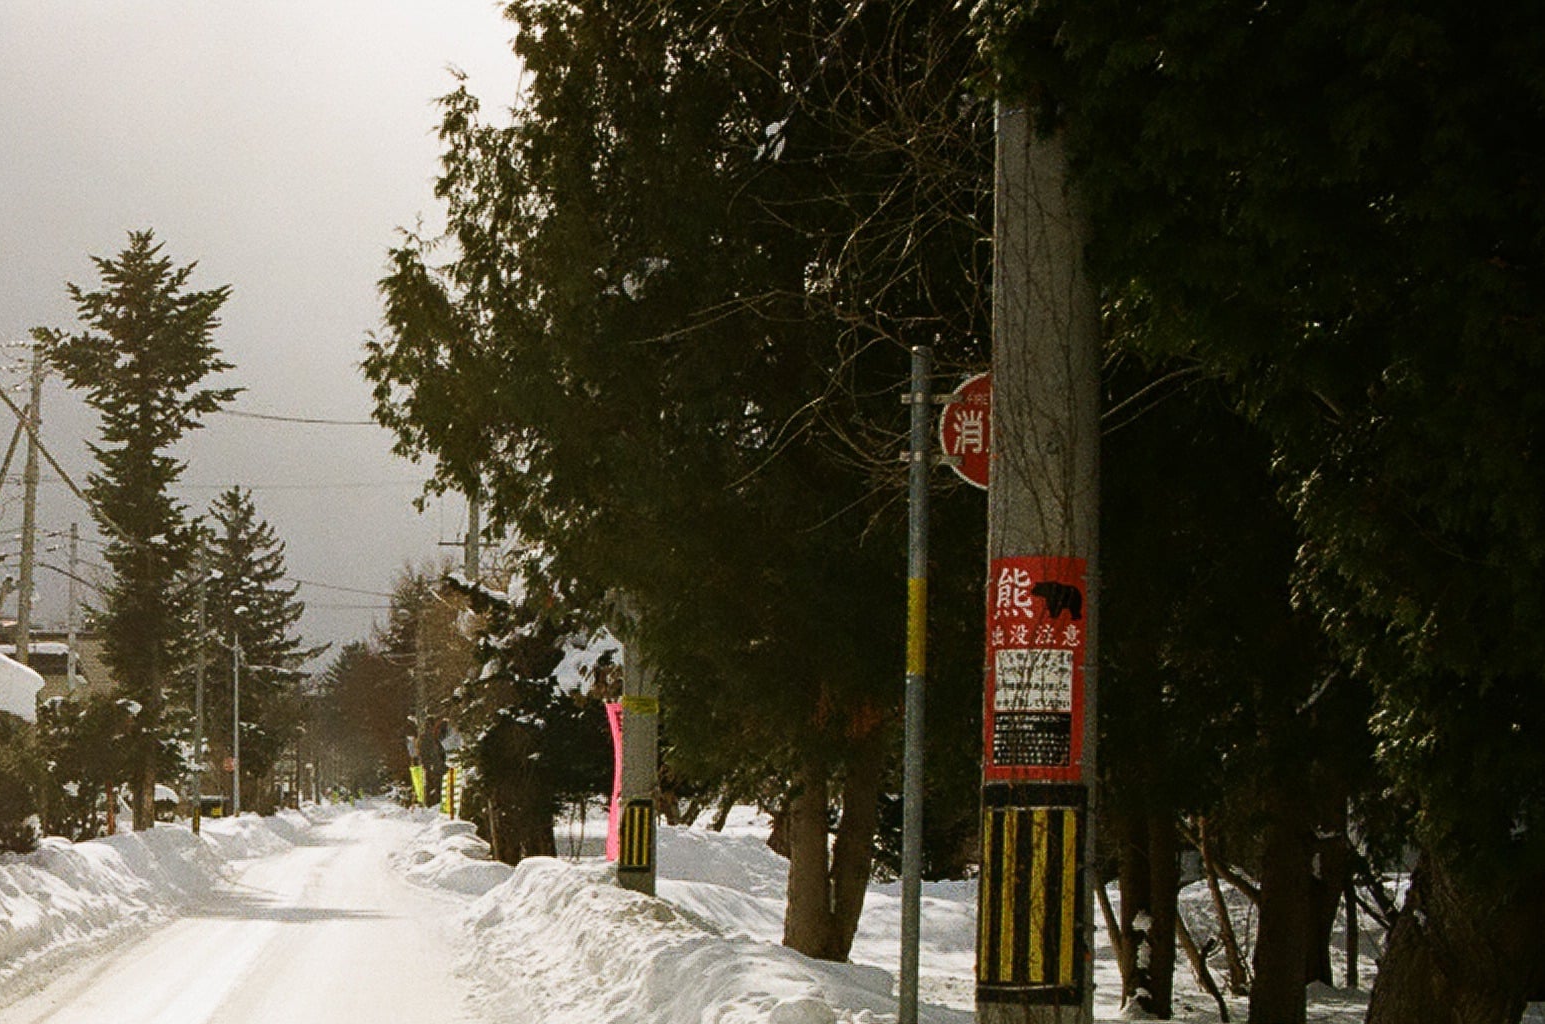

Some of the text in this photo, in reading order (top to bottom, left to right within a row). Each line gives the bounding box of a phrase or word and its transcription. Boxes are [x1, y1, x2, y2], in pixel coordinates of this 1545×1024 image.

[993, 567, 1034, 620] 熊
[991, 623, 1081, 647] 出没注意
